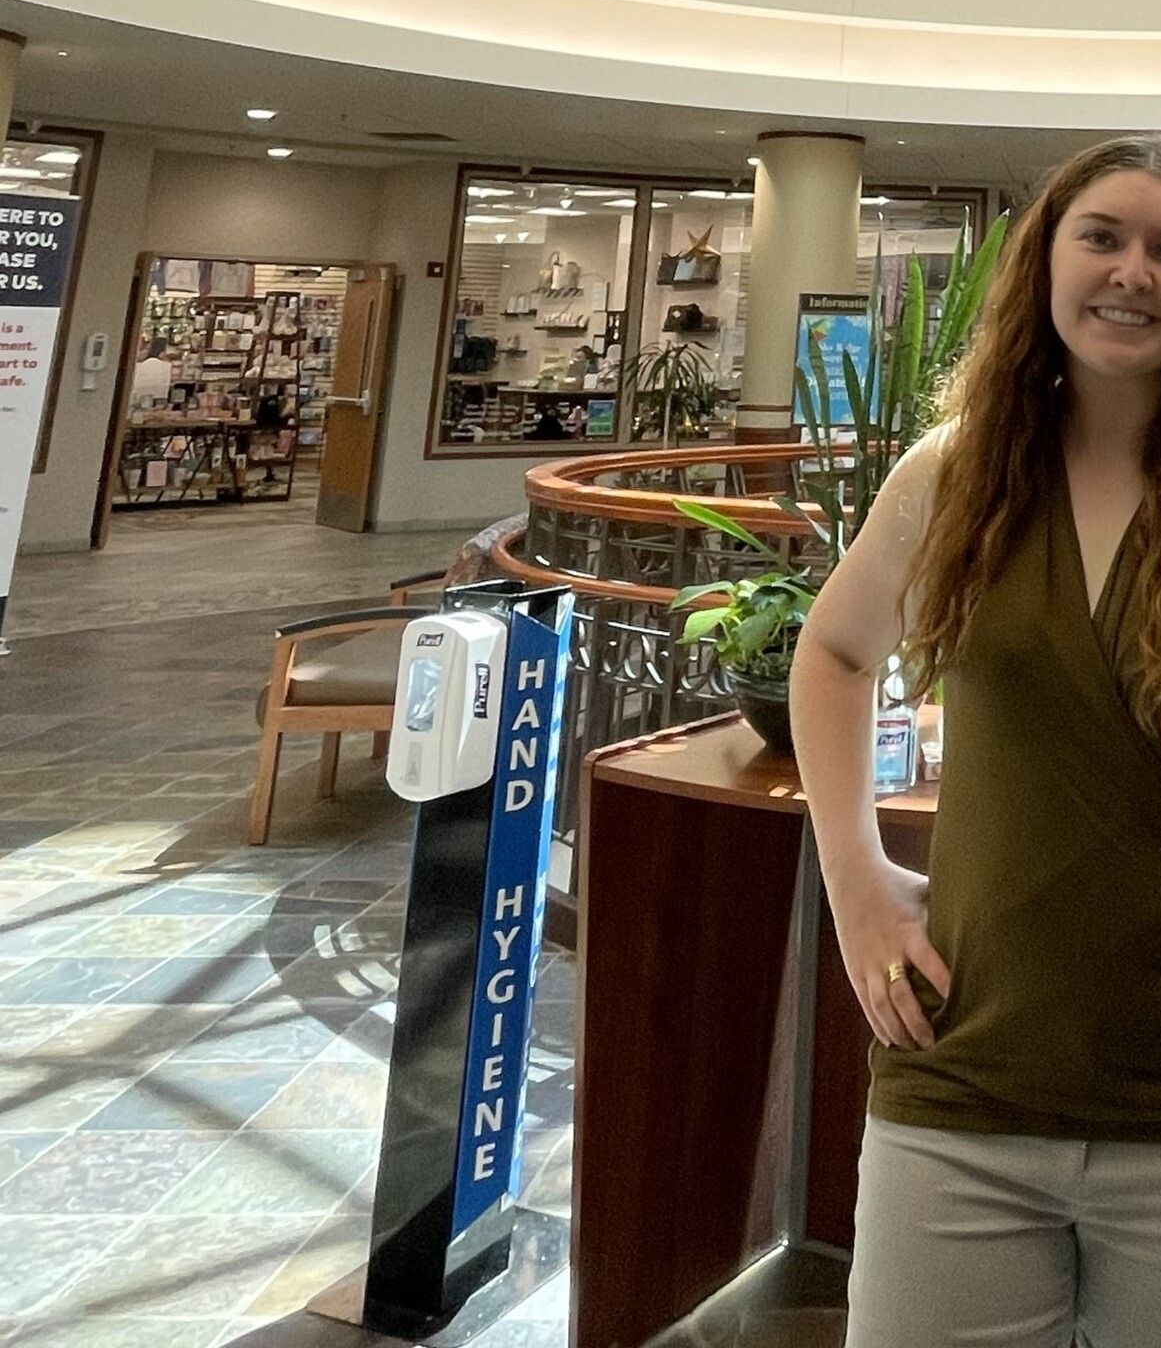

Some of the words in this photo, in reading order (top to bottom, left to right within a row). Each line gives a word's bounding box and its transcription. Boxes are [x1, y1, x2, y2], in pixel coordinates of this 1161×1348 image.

[39, 211, 64, 226] TO
[14, 231, 58, 250] YOU,
[12, 274, 44, 290] US.
[22, 358, 38, 369] to
[505, 658, 546, 812] HAND
[473, 885, 524, 1181] HYGIENE
